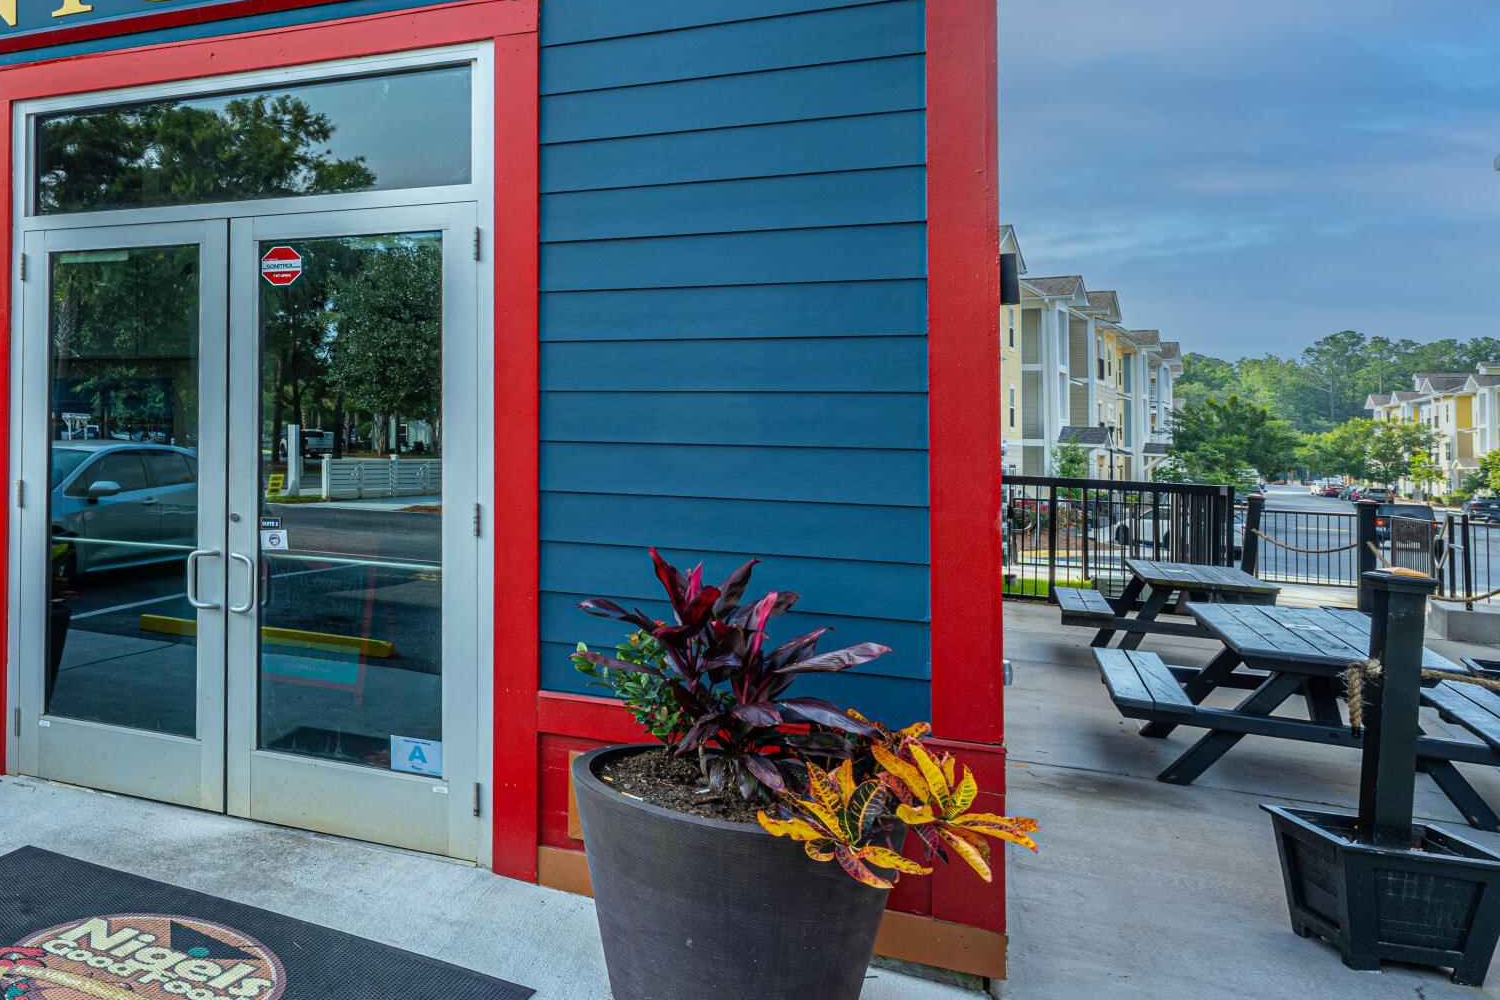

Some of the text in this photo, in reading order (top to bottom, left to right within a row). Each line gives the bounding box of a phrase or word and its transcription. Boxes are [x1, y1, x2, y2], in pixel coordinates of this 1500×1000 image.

[408, 745, 427, 764] A
[41, 937, 142, 977] Good
[60, 917, 272, 997] Nigels
